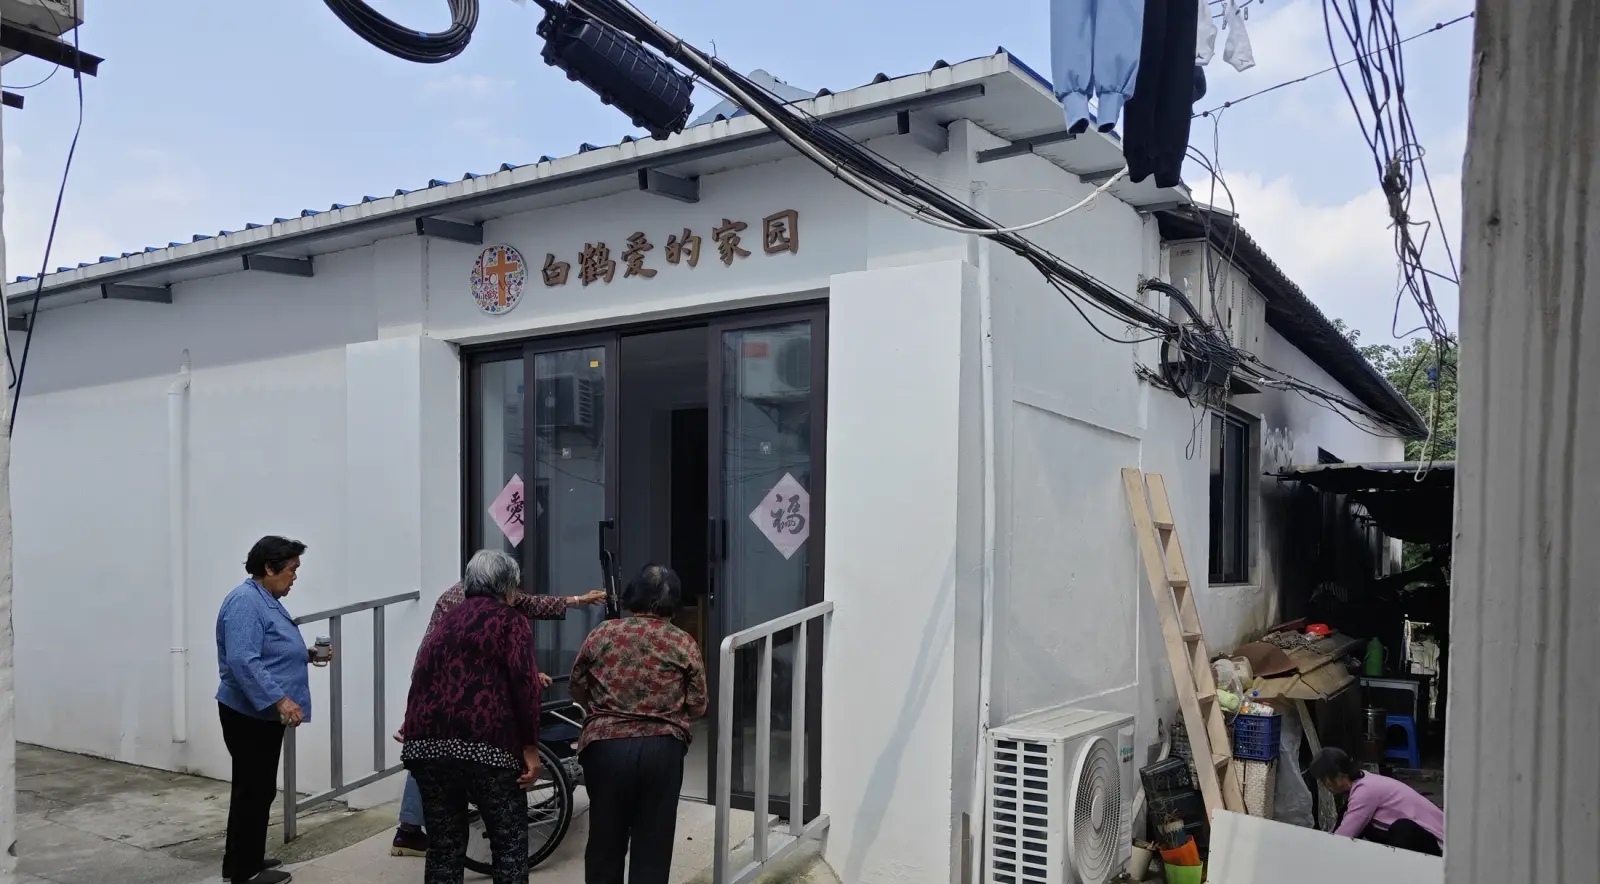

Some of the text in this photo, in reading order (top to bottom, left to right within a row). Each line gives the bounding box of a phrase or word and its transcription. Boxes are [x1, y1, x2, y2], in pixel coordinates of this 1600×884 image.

[541, 208, 799, 287] 白鹤爱的家园
[770, 493, 806, 535] 福
